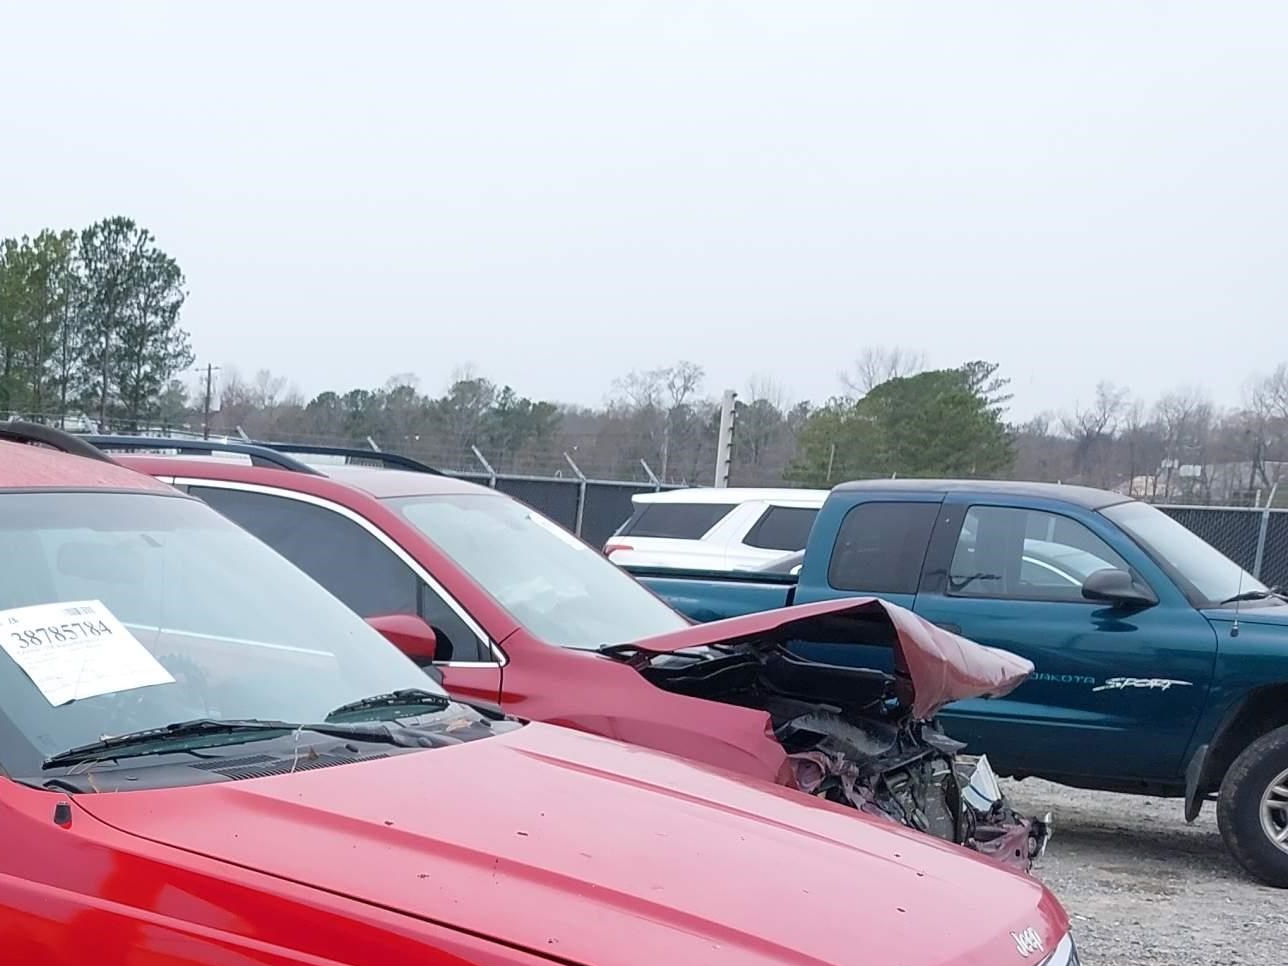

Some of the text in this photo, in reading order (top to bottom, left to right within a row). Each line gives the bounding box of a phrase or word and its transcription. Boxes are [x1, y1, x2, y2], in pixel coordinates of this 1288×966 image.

[10, 619, 113, 649] 38785784
[1092, 676, 1194, 693] SPORT
[1009, 926, 1044, 958] Jeep
